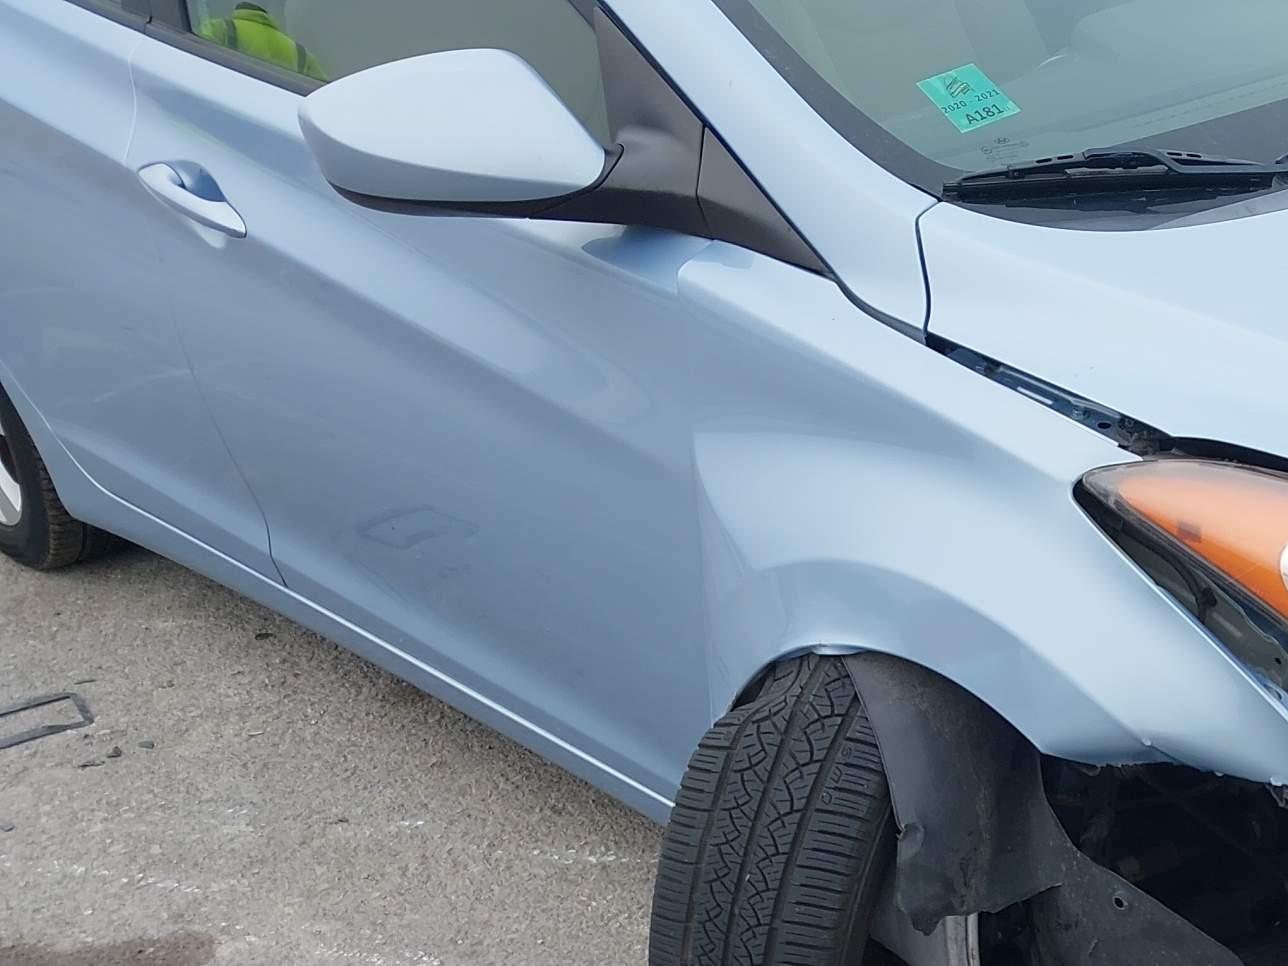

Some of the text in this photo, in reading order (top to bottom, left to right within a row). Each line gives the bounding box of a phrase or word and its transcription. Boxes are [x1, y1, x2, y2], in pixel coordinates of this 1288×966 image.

[941, 100, 967, 114] 2020
[974, 88, 1000, 102] 2021
[965, 103, 1004, 125] A181
